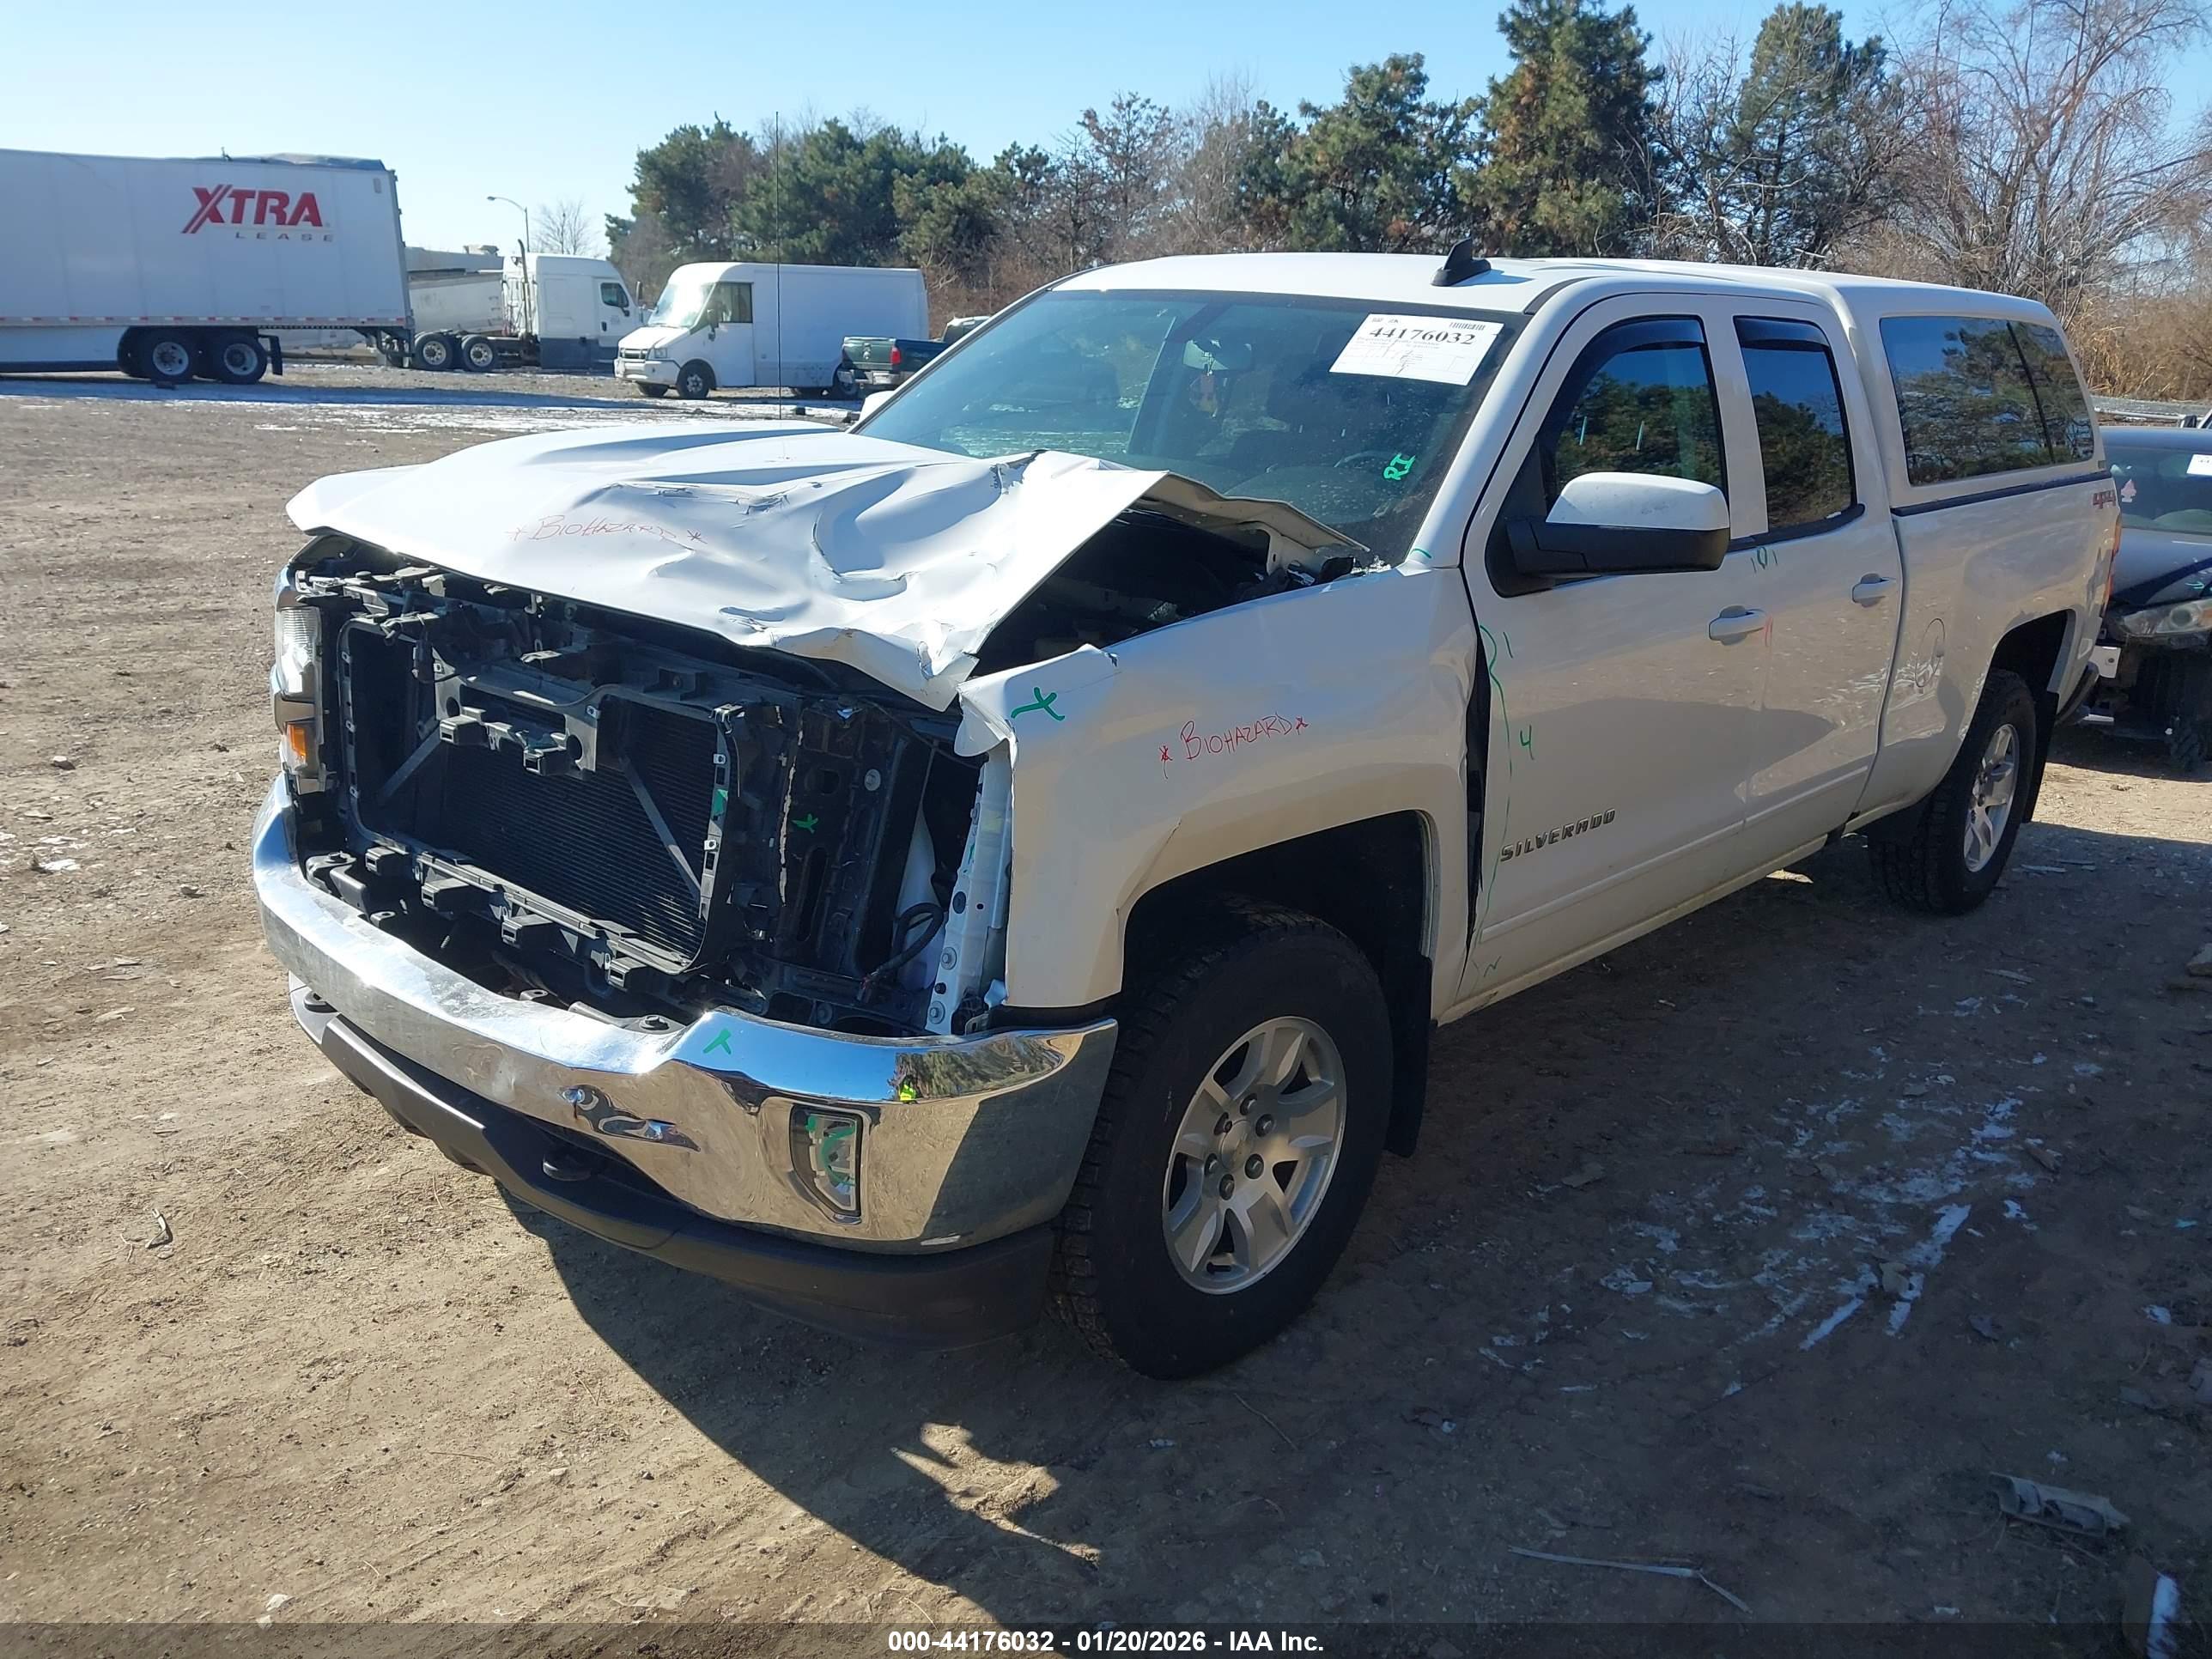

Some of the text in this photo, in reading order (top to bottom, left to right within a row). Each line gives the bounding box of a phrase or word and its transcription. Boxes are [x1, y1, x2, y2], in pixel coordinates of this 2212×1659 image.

[181, 184, 324, 234] XTRA
[235, 231, 334, 242] LEASE
[1370, 326, 1476, 345] 44176032
[1180, 712, 1291, 761] BIOHAZARD
[1500, 808, 1616, 862] SILVERADO
